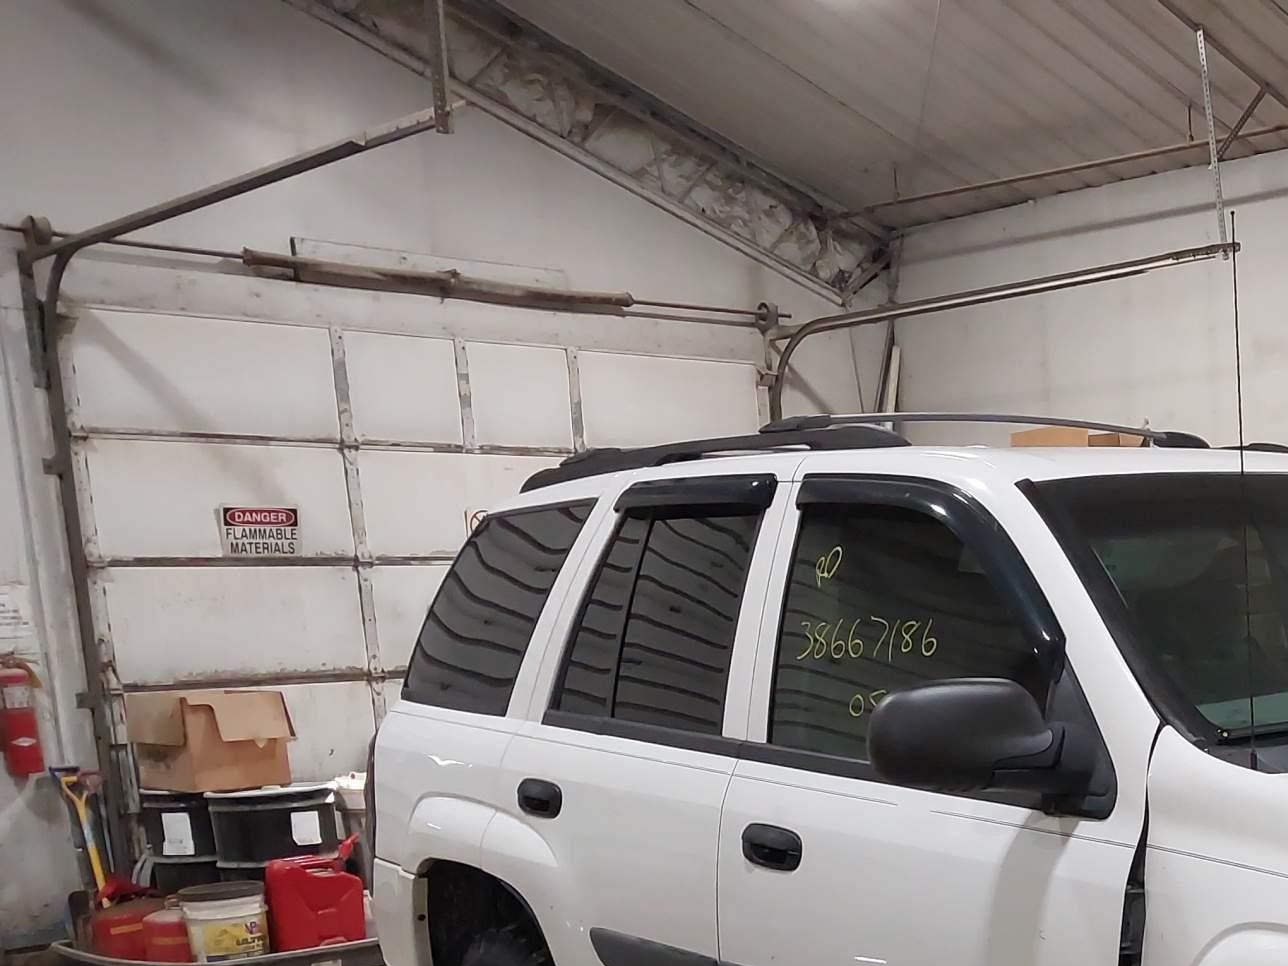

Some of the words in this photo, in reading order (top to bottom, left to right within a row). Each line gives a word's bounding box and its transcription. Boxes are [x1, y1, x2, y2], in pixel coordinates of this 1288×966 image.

[234, 512, 287, 522] DANGER
[225, 527, 298, 541] FLAMMABLE
[230, 542, 296, 555] MATERIALS
[796, 615, 938, 664] 38667186
